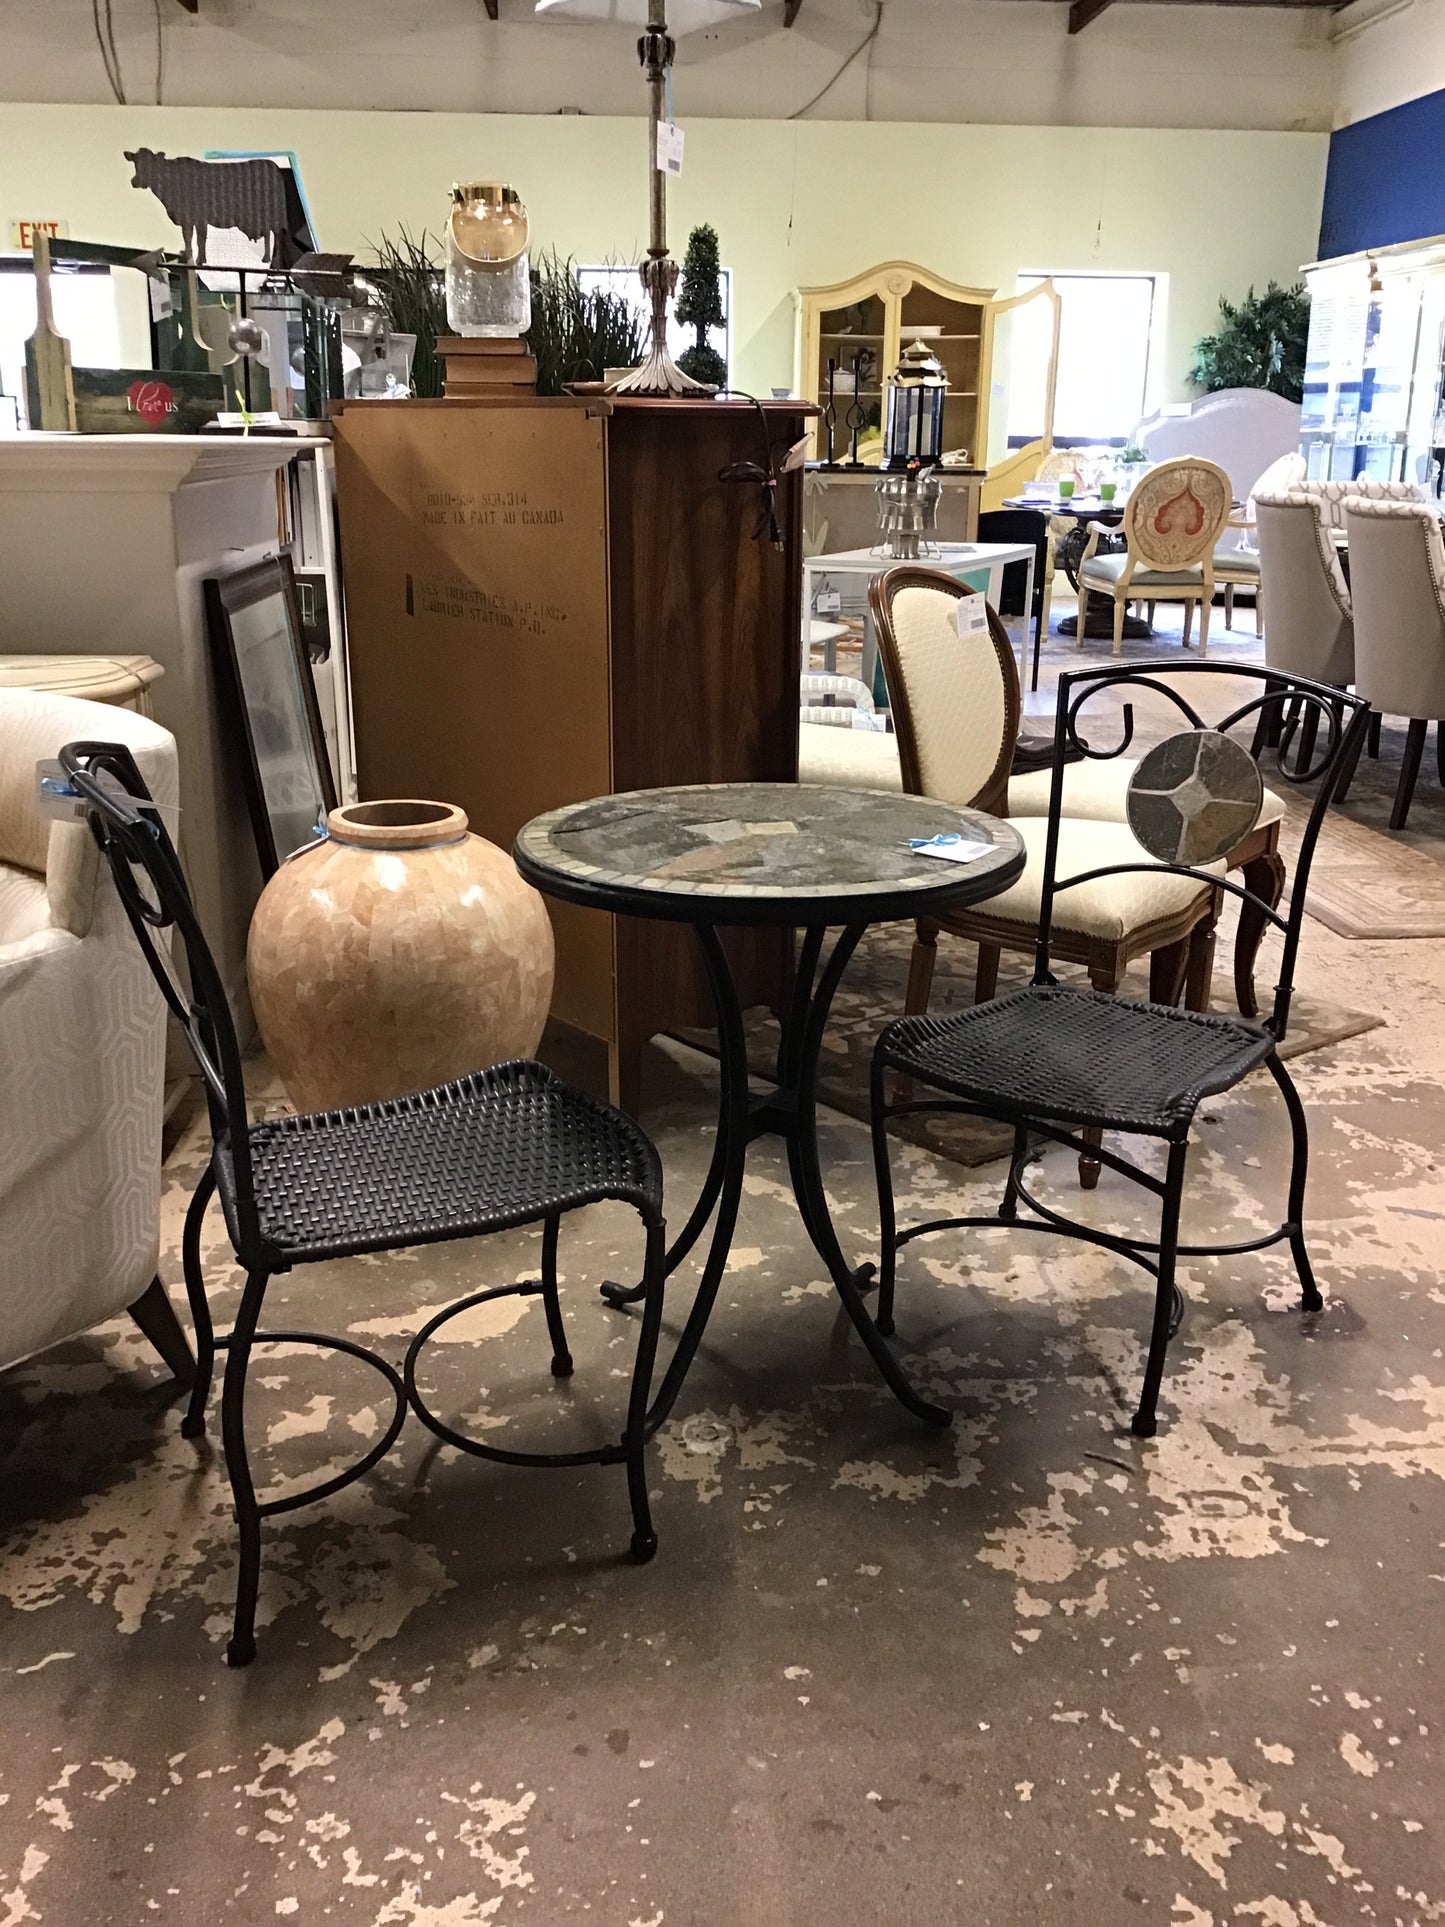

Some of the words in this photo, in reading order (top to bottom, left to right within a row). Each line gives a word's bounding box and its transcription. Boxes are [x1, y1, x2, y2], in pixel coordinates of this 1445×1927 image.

[165, 400, 179, 413] us
[423, 510, 447, 526] MADE
[454, 510, 466, 525] IN
[470, 510, 496, 525] FAIT
[503, 510, 516, 525] AU
[522, 509, 564, 525] CANADA
[422, 598, 464, 618] LAURIER
[470, 608, 514, 629] STATION
